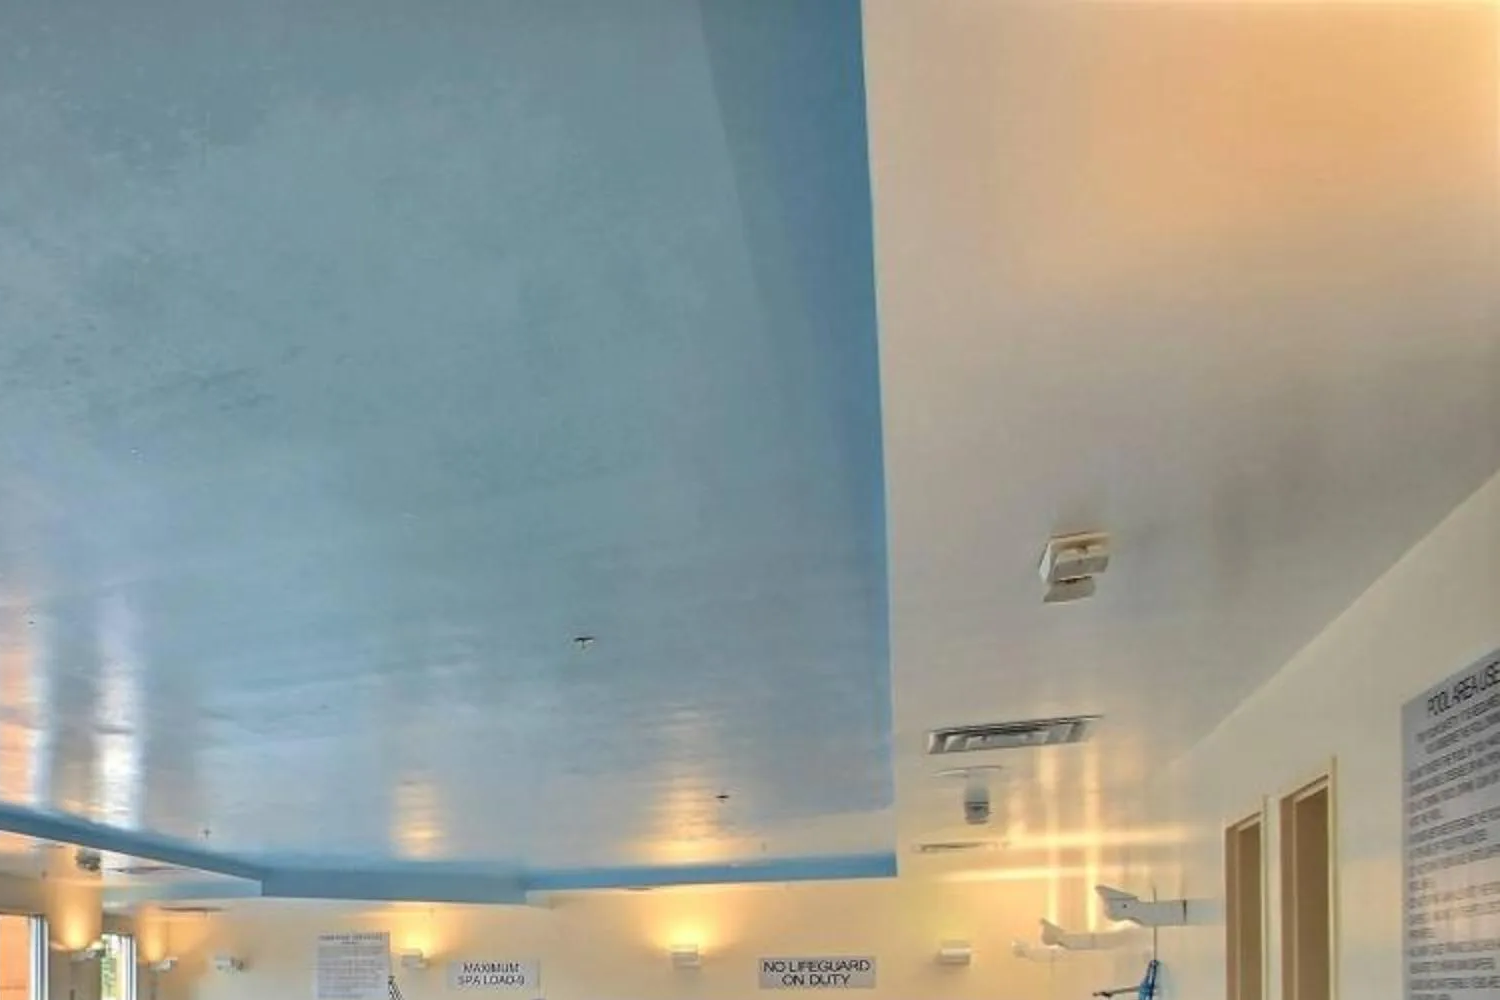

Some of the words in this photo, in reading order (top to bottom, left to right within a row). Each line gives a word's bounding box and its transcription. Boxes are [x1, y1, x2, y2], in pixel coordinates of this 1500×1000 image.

[1427, 688, 1452, 716] POOL
[1453, 674, 1480, 704] AREA
[463, 962, 520, 973] MAXIMUM
[763, 960, 786, 973] NO
[789, 959, 871, 973] LIFEGUARD
[458, 975, 481, 986] SPA
[483, 975, 515, 986] LOAD
[781, 974, 804, 986] ON
[809, 973, 851, 987] DUTY
